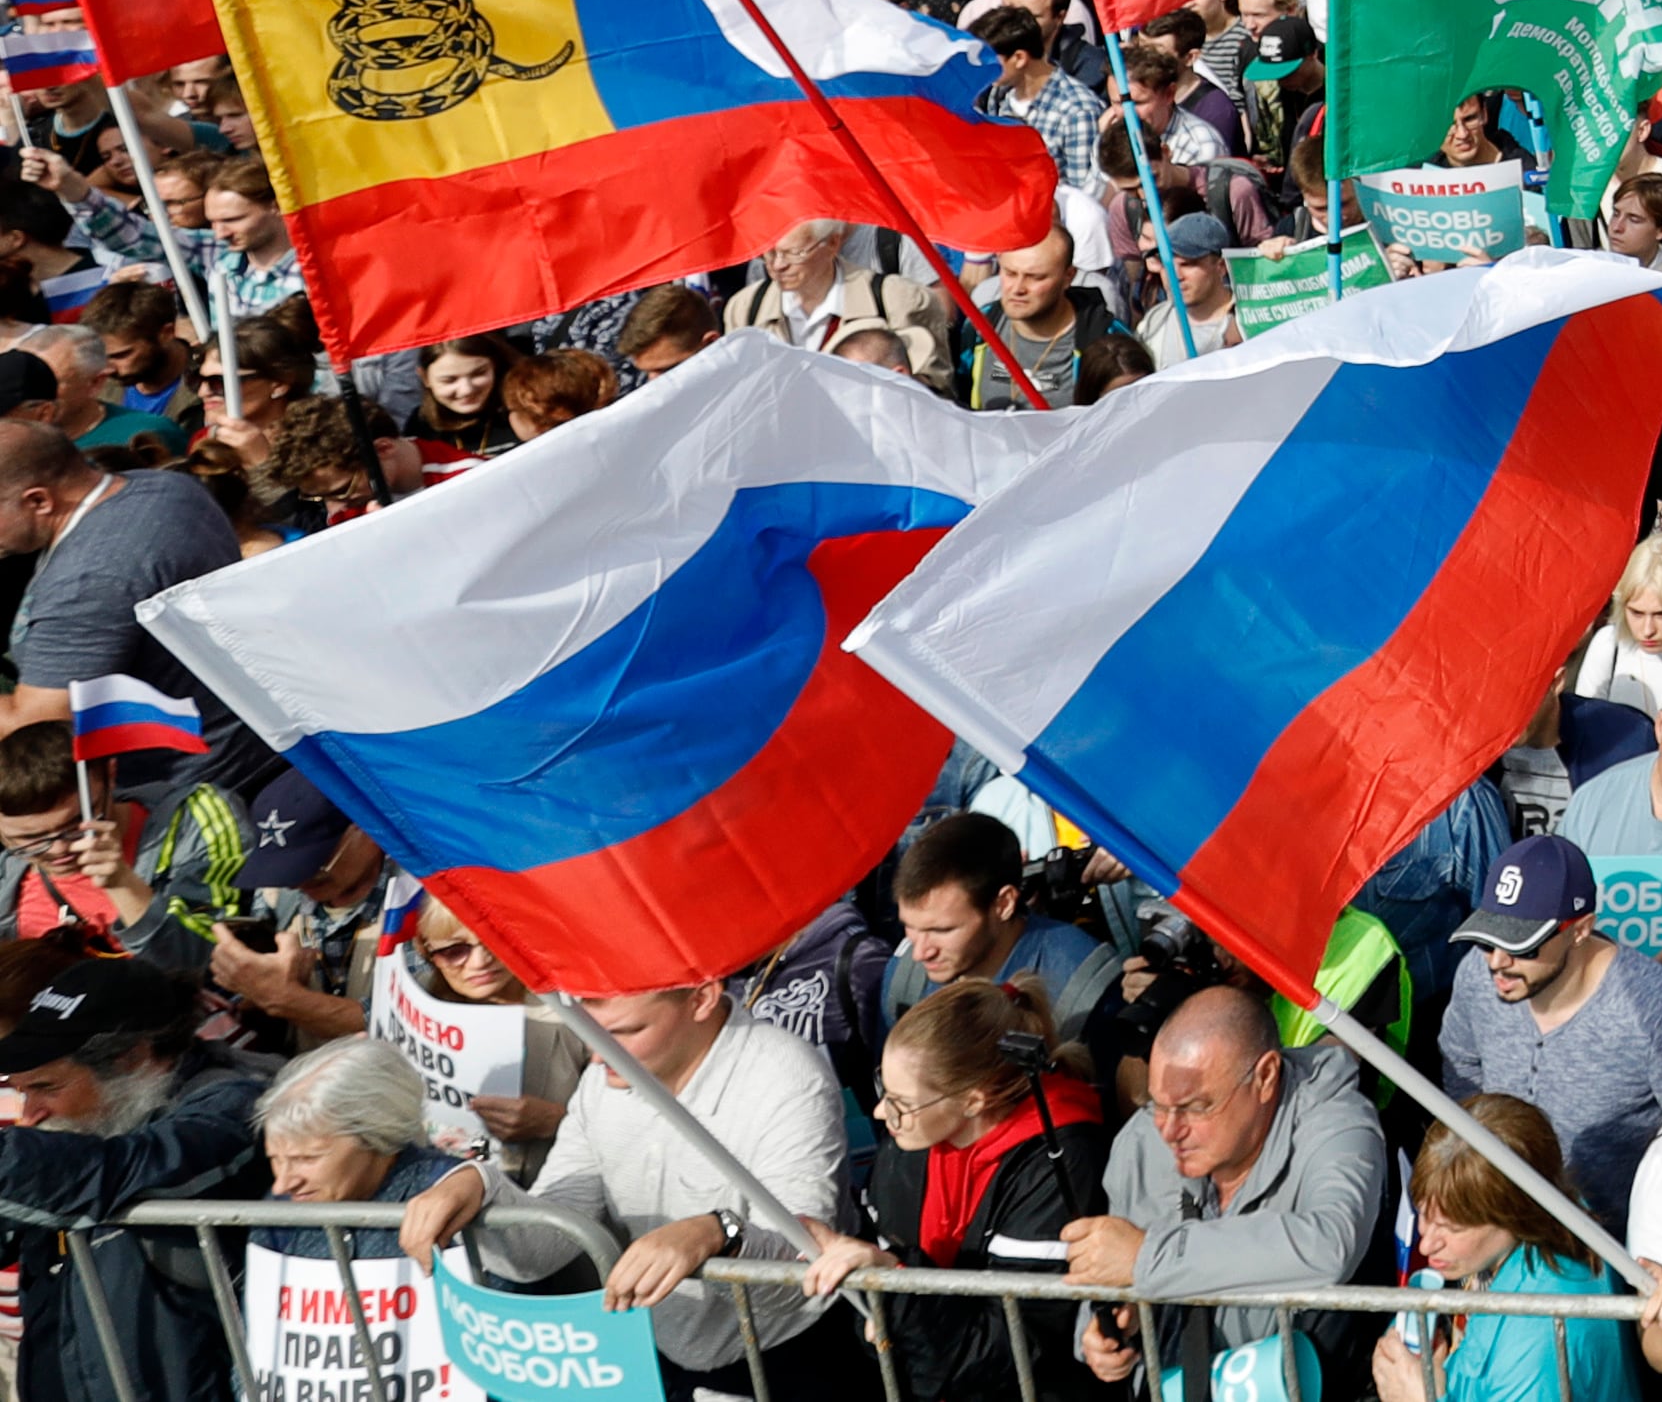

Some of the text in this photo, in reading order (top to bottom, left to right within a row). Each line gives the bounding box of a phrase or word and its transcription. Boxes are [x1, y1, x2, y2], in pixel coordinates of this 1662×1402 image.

[1373, 203, 1493, 230] ЛЮБОВЬ
[1391, 223, 1504, 252] СОБОЛЬ
[278, 1284, 418, 1324] Я ИМЕЮ
[285, 1330, 403, 1370] ПРАВО
[460, 1329, 626, 1391] СОБОЛЬ
